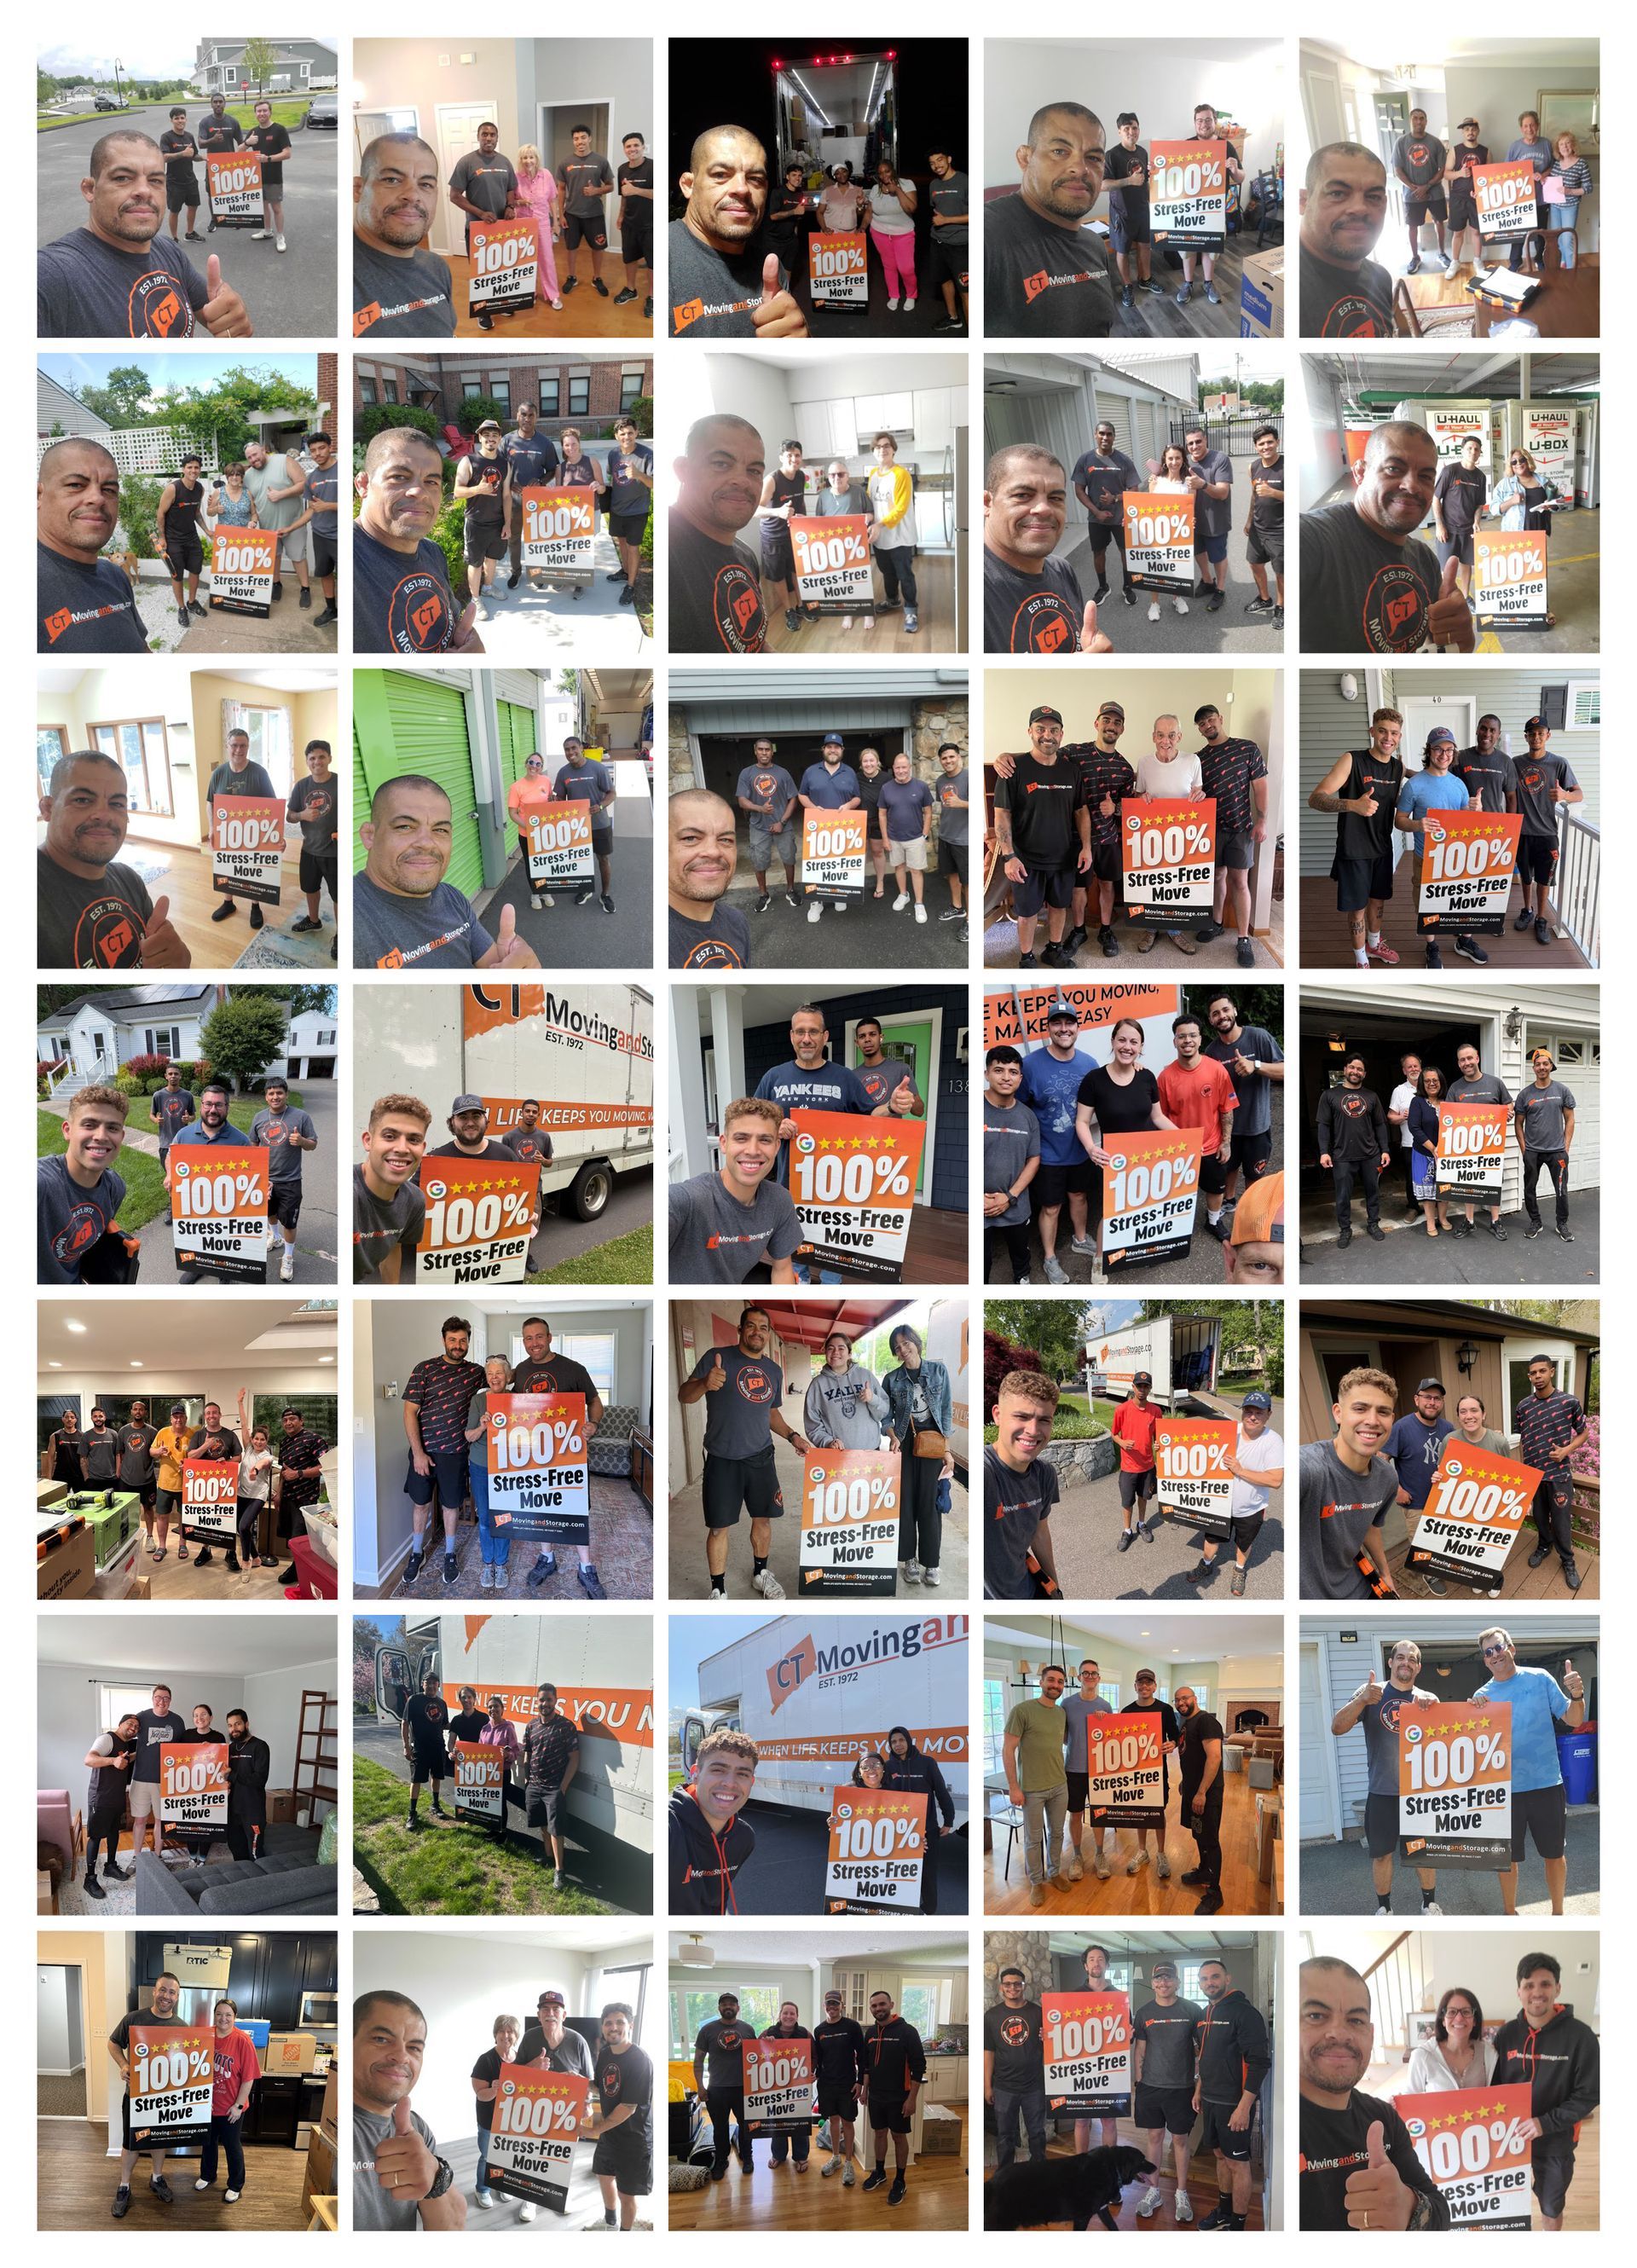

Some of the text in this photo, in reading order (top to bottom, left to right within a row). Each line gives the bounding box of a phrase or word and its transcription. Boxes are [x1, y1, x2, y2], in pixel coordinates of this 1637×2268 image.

[212, 167, 259, 194] 100%
[1154, 161, 1222, 200] 100%
[214, 192, 260, 205] Stress-Free
[1478, 176, 1532, 211] 100%
[228, 203, 250, 213] Move
[1154, 198, 1222, 217] Stress-Free
[1482, 202, 1534, 223] Stress-Free
[1174, 216, 1206, 228] Move
[1499, 217, 1523, 229] Move
[474, 234, 535, 274] 100%
[813, 249, 864, 276] 100%
[474, 264, 534, 289] Stress-Free
[814, 276, 865, 288] Stress-Free
[1030, 276, 1043, 291] CT
[493, 281, 520, 297] Move
[830, 287, 853, 298] Move
[1244, 290, 1267, 311] medium
[357, 310, 373, 325] CT
[682, 306, 695, 321] CT
[1437, 414, 1481, 424] U-HAUL
[1531, 414, 1569, 422] U-HAUL
[1530, 440, 1569, 451] U-BOX
[527, 505, 591, 540] 100%
[1127, 515, 1190, 546] 100%
[529, 540, 591, 554] Stress-Free
[798, 535, 865, 574] 100%
[1130, 548, 1190, 561] Stress-Free
[215, 547, 272, 572] 100%
[547, 553, 576, 565] Move
[1148, 561, 1176, 572] Move
[1478, 550, 1542, 587] 100%
[214, 576, 269, 587] Stress-Free
[802, 569, 868, 588] Stress-Free
[229, 587, 255, 597] Move
[824, 584, 854, 598] Move
[1479, 582, 1543, 602] Stress-Free
[1392, 603, 1409, 618] CT
[1499, 599, 1529, 611] Move
[51, 615, 67, 629] CT
[217, 819, 280, 849] 100%
[530, 816, 588, 853] 100%
[807, 829, 863, 858] 100%
[1127, 823, 1211, 868] 100%
[217, 852, 279, 865] Stress-Free
[533, 846, 590, 867] Stress-Free
[806, 859, 862, 871] Stress-Free
[1429, 838, 1512, 879] 100%
[234, 865, 263, 877] Move
[551, 862, 577, 875] Move
[822, 871, 848, 882] Move
[1128, 866, 1211, 888] Stress-Free
[1152, 886, 1190, 902] Move
[1426, 877, 1507, 899] Stress-Free
[1449, 894, 1487, 911] Move
[107, 932, 124, 952] CT
[998, 994, 1059, 1016] KEEPS
[1065, 990, 1096, 1004] YOU
[546, 1031, 583, 1050] EST. 1972
[773, 1084, 842, 1099] YANKEES
[541, 1109, 646, 1125] KEEPS YOU MOVING,
[1442, 1124, 1502, 1155] 100%
[1440, 1156, 1501, 1171] Stress-Free
[795, 1154, 910, 1202] 100%
[1109, 1154, 1195, 1212] 100%
[1457, 1171, 1485, 1182] Move
[176, 1174, 263, 1216] 100%
[425, 1191, 529, 1247] 100%
[796, 1206, 904, 1229] Stress-Free
[1109, 1197, 1193, 1235] Stress-Free
[178, 1219, 263, 1235] Stress-Free
[1135, 1219, 1173, 1242] Move
[202, 1237, 241, 1252] Move
[824, 1228, 874, 1247] Move
[423, 1240, 524, 1271] Stress-Free
[454, 1262, 500, 1284] Move
[493, 1420, 582, 1469] 100%
[1160, 1444, 1229, 1477] 100%
[186, 1477, 234, 1502] 100%
[494, 1469, 583, 1491] Stress-Free
[1161, 1480, 1229, 1494] Stress-Free
[184, 1505, 234, 1515] Stress-Free
[520, 1491, 562, 1509] Move
[809, 1477, 895, 1524] 100%
[1179, 1495, 1211, 1507] Move
[1436, 1478, 1527, 1522] 100%
[199, 1515, 222, 1525] Move
[807, 1524, 894, 1548] Stress-Free
[1423, 1519, 1511, 1546] Stress-Free
[833, 1546, 874, 1564] Move
[1417, 1552, 1429, 1560] CT
[1443, 1538, 1485, 1558] Move
[778, 1653, 805, 1688] CT
[818, 1672, 858, 1688] EST. 1972
[573, 1700, 632, 1727] YOU
[759, 1740, 868, 1756] WHEN LIFE KEEPS
[1092, 1733, 1159, 1773] 100%
[1405, 1733, 1505, 1790] 100%
[164, 1762, 224, 1795] 100%
[457, 1762, 500, 1785] 100%
[1093, 1769, 1160, 1791] Stress-Free
[165, 1794, 225, 1808] Stress-Free
[457, 1788, 500, 1798] Stress-Free
[1114, 1789, 1144, 1803] Move
[1406, 1788, 1506, 1815] Stress-Free
[469, 1798, 489, 1809] Move
[182, 1809, 211, 1820] Move
[1435, 1813, 1482, 1833] Move
[836, 1818, 920, 1858] 100%
[1410, 1840, 1506, 1853] CT MovingandStorage.com
[832, 1862, 917, 1879] Stress-Free
[856, 1881, 897, 1897] Move
[187, 1957, 208, 1965] RTIC
[1048, 2014, 1125, 2060] 100%
[135, 2049, 210, 2093] 100%
[747, 2056, 807, 2092] 100%
[1050, 2054, 1126, 2079] Stress-Free
[1073, 2075, 1109, 2092] Move
[135, 2088, 210, 2112] Stress-Free
[748, 2087, 809, 2109] Stress-Free
[159, 2107, 193, 2123] Move
[499, 2097, 576, 2135] 100%
[766, 2103, 795, 2117] Move
[494, 2136, 571, 2158] Stress-Free
[1414, 2117, 1524, 2179] 100%
[512, 2154, 549, 2173] Move
[1452, 2196, 1501, 2219] Move
